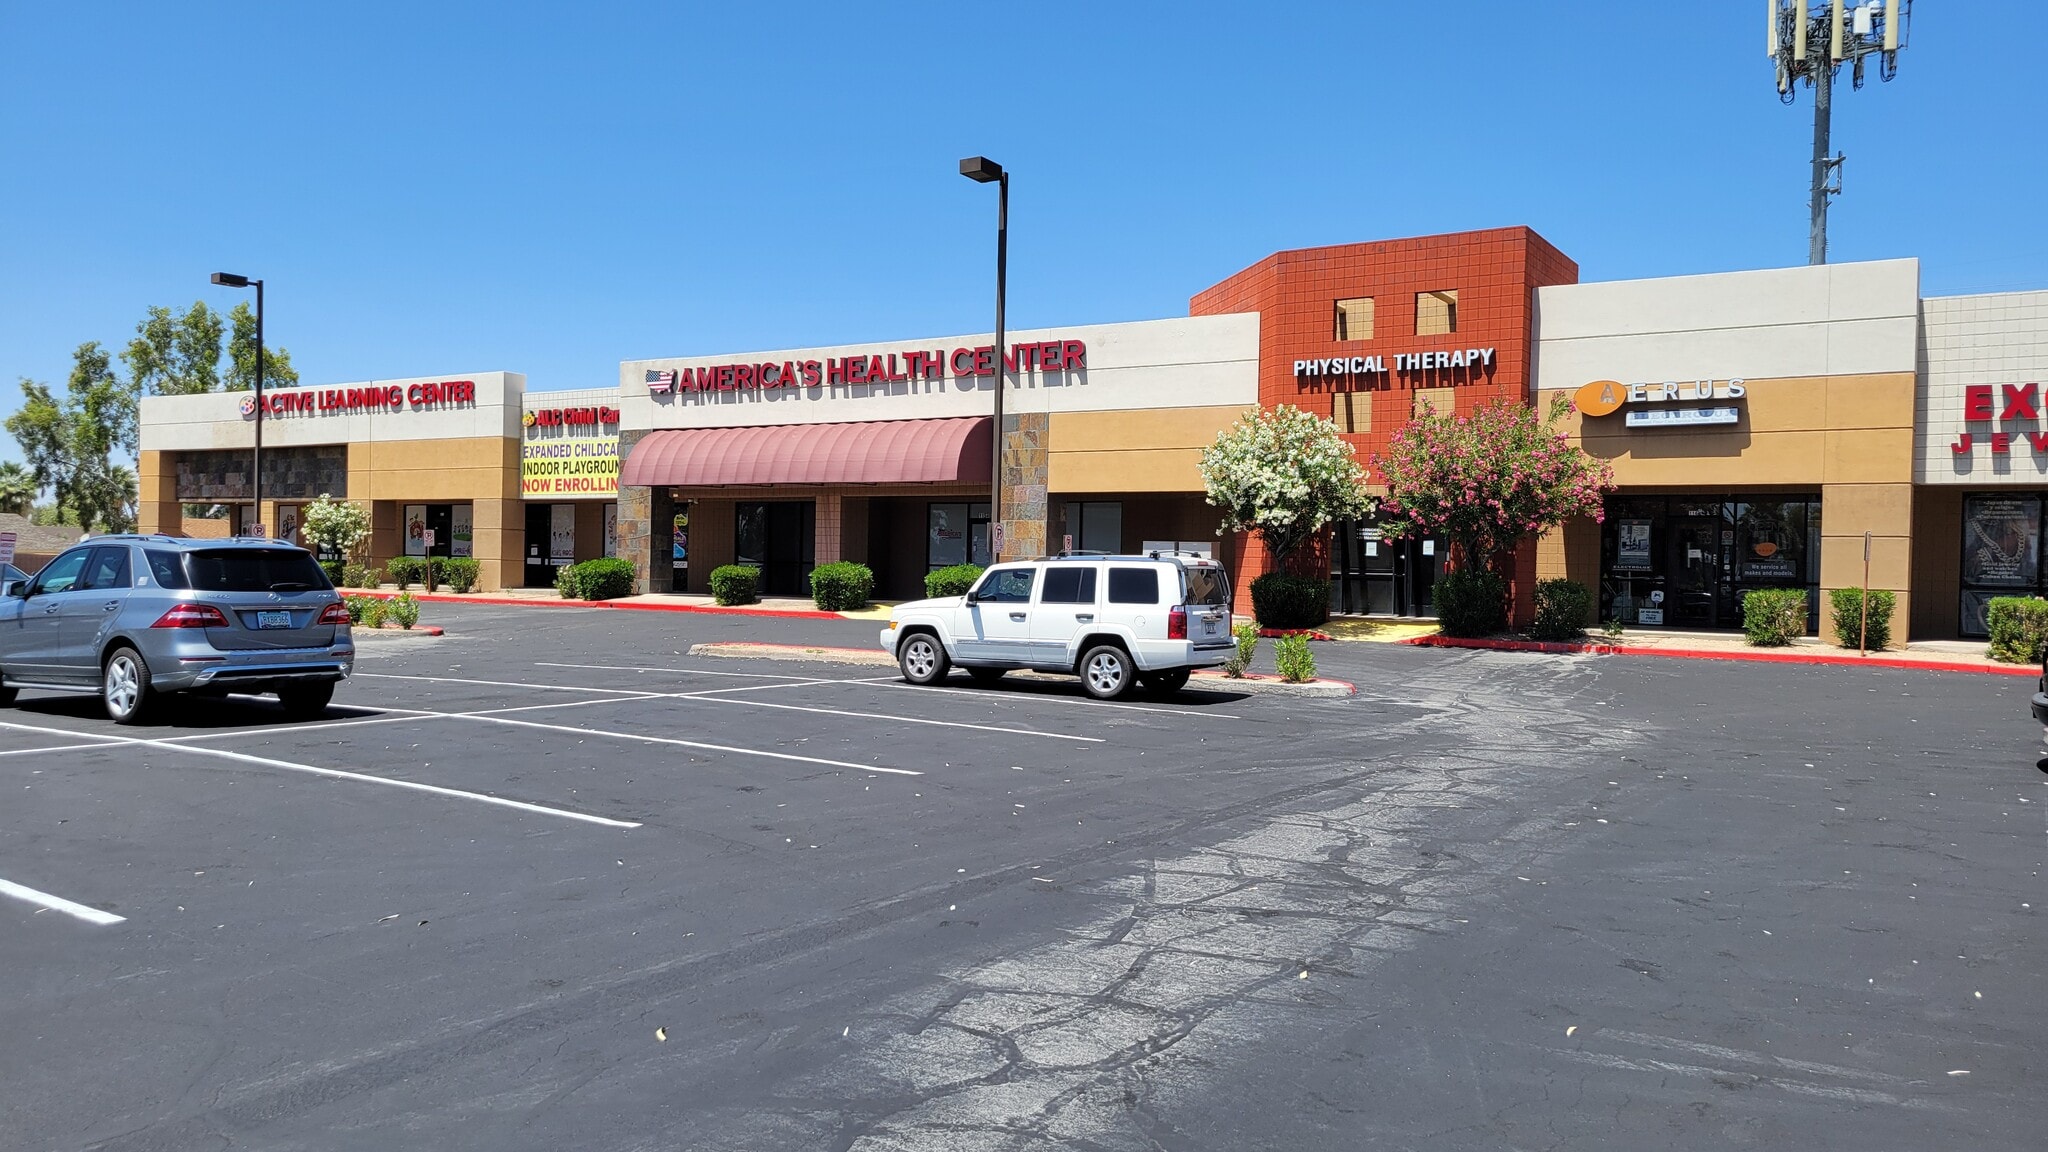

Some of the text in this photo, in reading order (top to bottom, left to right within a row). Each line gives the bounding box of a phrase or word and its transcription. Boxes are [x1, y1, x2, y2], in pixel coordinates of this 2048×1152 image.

[678, 339, 1086, 392] AMERICA'S HEALTH CENTER
[1293, 347, 1494, 376] PHYSICAL THERAPY
[260, 380, 475, 414] ACTIVE LEARNING CENTER
[1964, 382, 2048, 421] EX
[536, 409, 561, 426] ALC
[563, 407, 597, 425] Child
[523, 444, 572, 459] EXPANDED
[523, 461, 560, 475] INDOOR
[522, 477, 618, 493] NOW ENROLLIN
